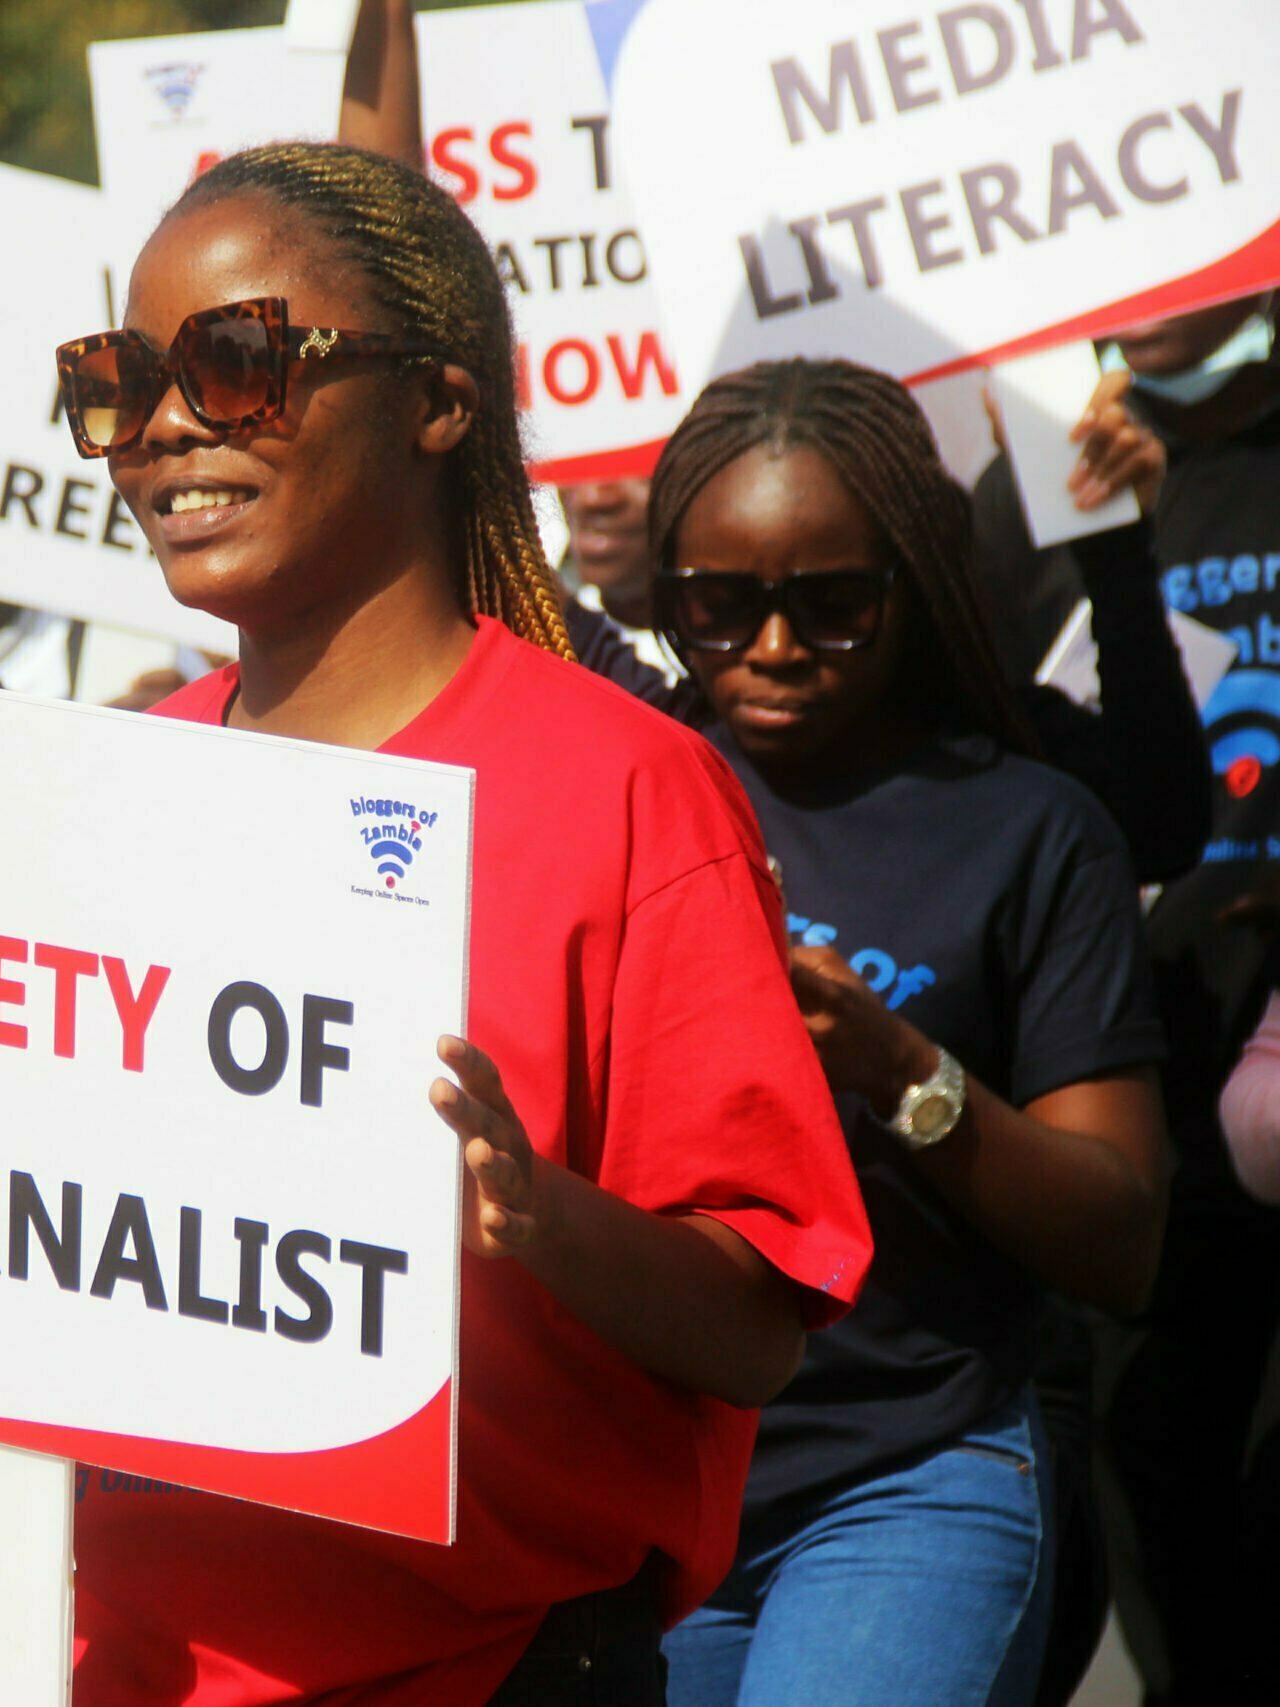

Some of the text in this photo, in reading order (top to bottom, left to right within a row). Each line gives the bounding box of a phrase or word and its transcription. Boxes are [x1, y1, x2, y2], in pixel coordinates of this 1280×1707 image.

[768, 0, 1144, 146] MEDIA
[738, 88, 1243, 322] LITERACY
[350, 796, 438, 828] bloggers of
[207, 980, 354, 1107] OF
